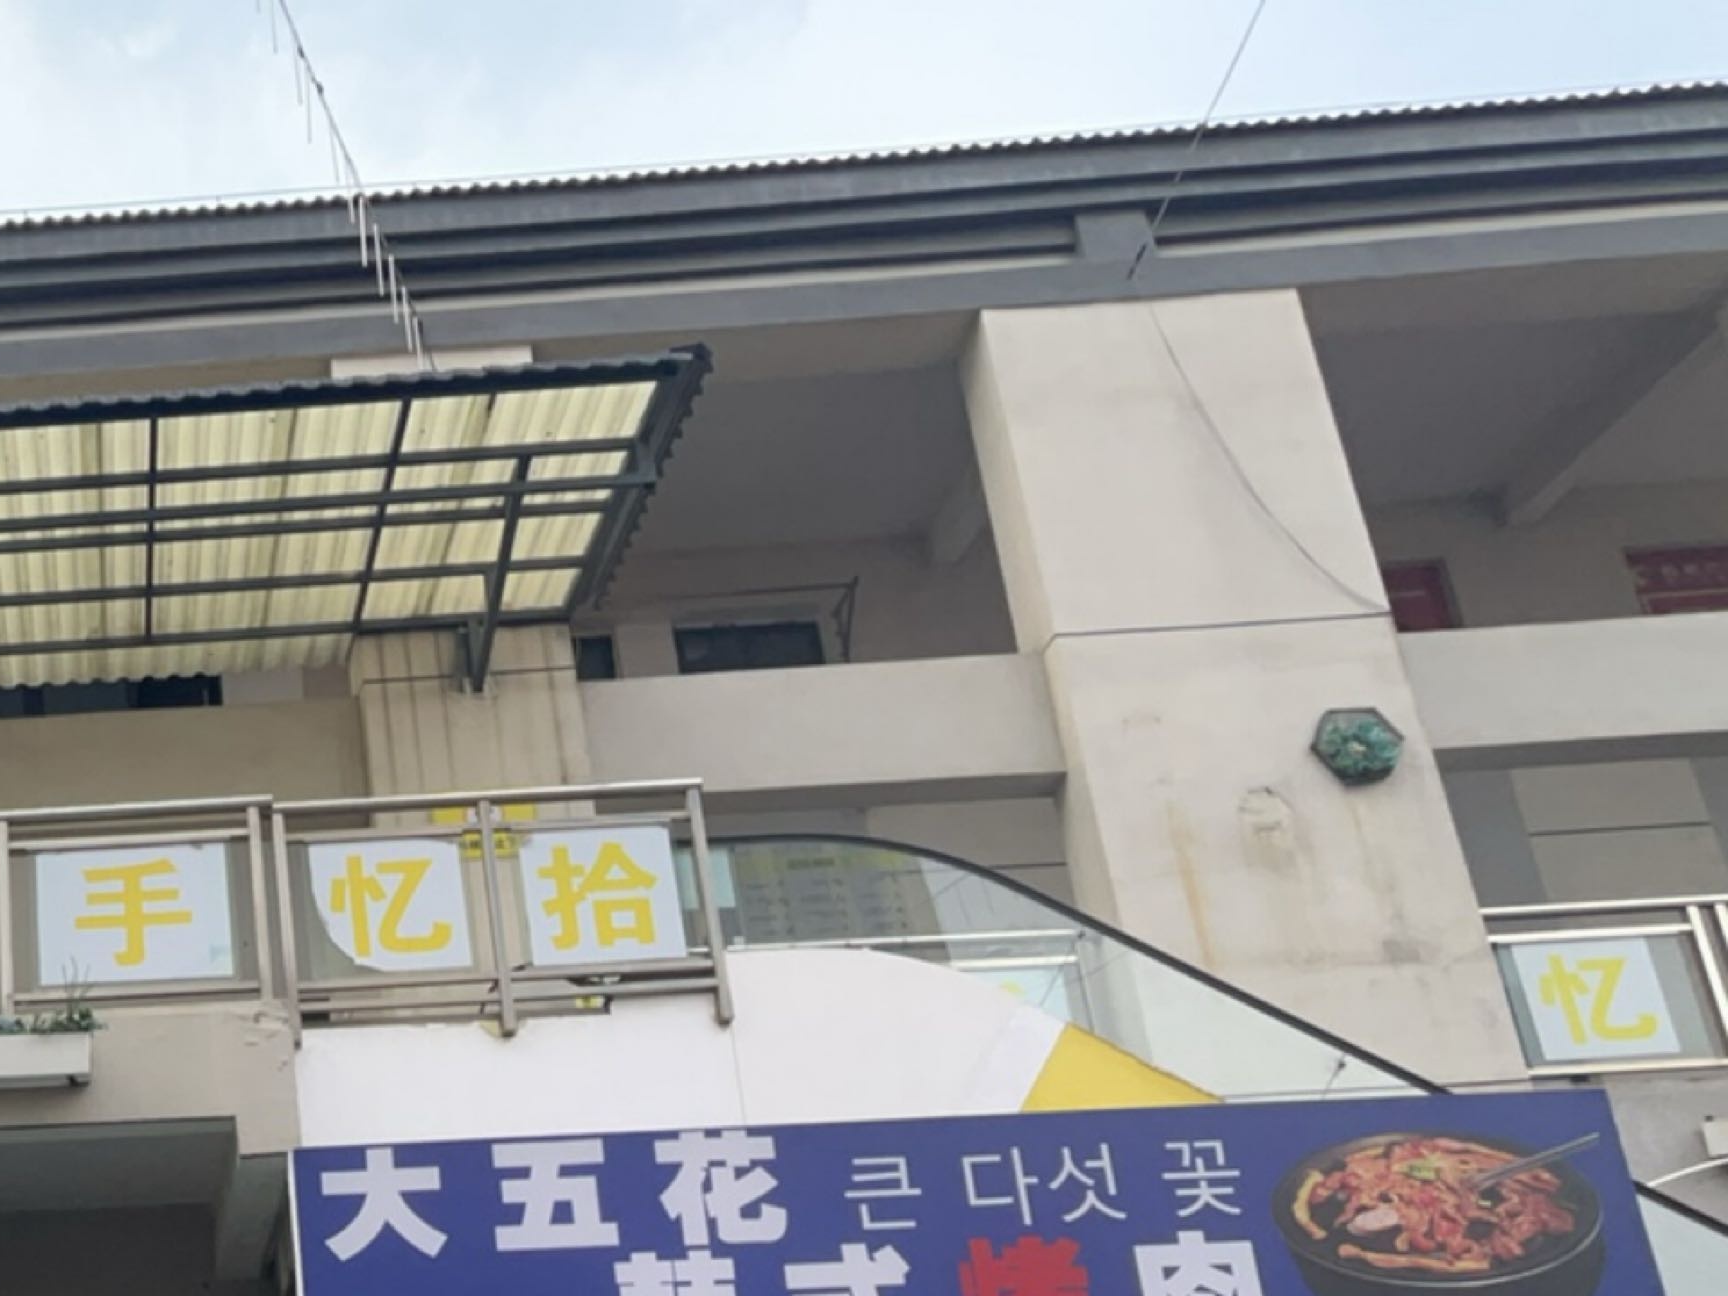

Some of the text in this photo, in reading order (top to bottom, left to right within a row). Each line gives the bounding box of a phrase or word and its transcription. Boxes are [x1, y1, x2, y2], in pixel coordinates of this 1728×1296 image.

[73, 857, 193, 967] 手
[328, 854, 453, 958] 忆
[536, 841, 658, 952] 拾
[1538, 953, 1658, 1046] 忆
[320, 1128, 788, 1262] 大五花
[843, 1139, 1242, 1231] 큰 다섯 꽃
